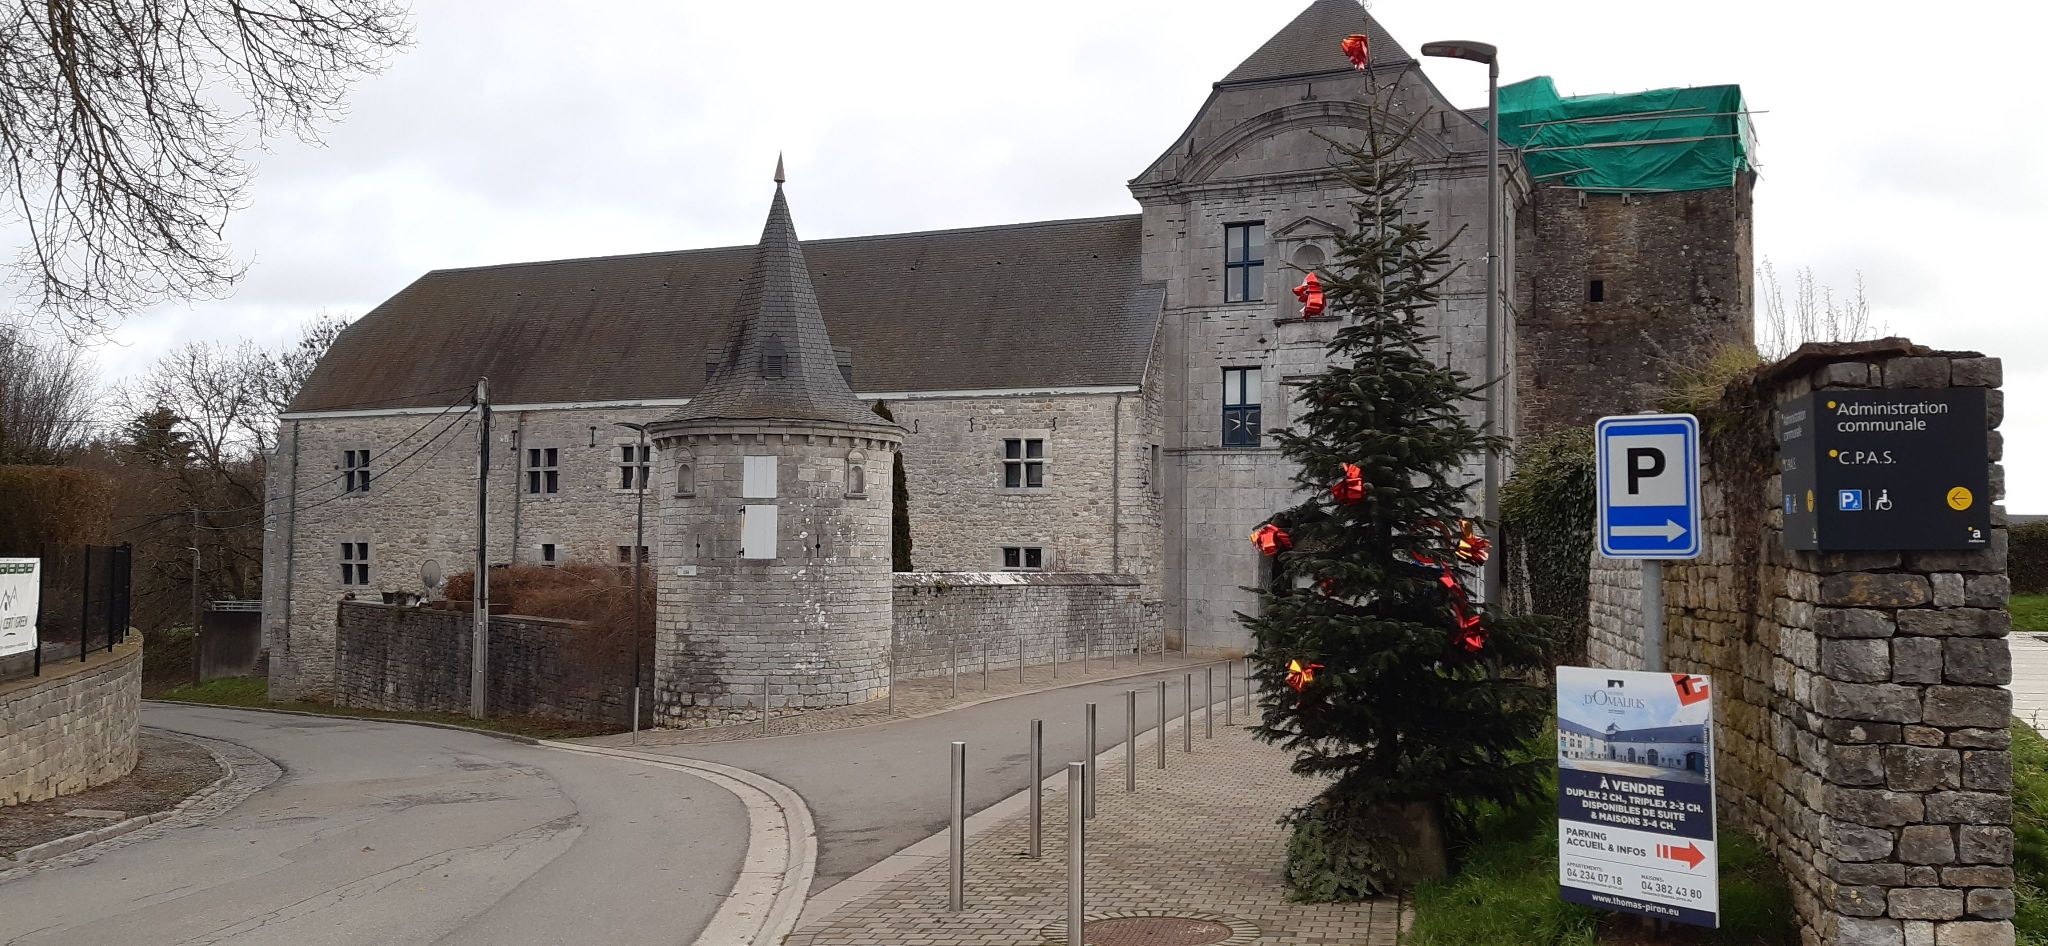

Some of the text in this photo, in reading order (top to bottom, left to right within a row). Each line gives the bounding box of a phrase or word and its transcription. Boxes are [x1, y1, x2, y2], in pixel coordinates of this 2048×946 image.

[1837, 401, 1948, 416] Administration
[1837, 417, 1927, 432] communale
[1838, 451, 1897, 465] C.P.A.S.
[1627, 447, 1666, 495] P
[1842, 492, 1854, 508] P
[1600, 776, 1664, 796] À VENDRE
[1566, 787, 1600, 799] DUPLEX
[1602, 792, 1608, 800] 2
[1628, 796, 1667, 808] TRIPLEX
[1669, 801, 1685, 811] 2-3
[1686, 803, 1704, 813] CH.
[1582, 800, 1686, 821] DISPONIBLES DE SUITE
[1590, 811, 1676, 831] & MAISONS 3-4 CH.
[1566, 827, 1607, 841] PARKING
[1566, 837, 1647, 857] ACCUEIL & INFOS
[1567, 867, 1578, 878] 04
[1580, 870, 1596, 881] 234
[1598, 873, 1609, 883] 07
[1611, 875, 1622, 886] 18
[1641, 880, 1653, 891] 04
[1655, 883, 1673, 895] 382
[1675, 886, 1687, 897] 43
[1690, 889, 1702, 899] 80
[1592, 894, 1679, 916] www.thomas-piron.eu
